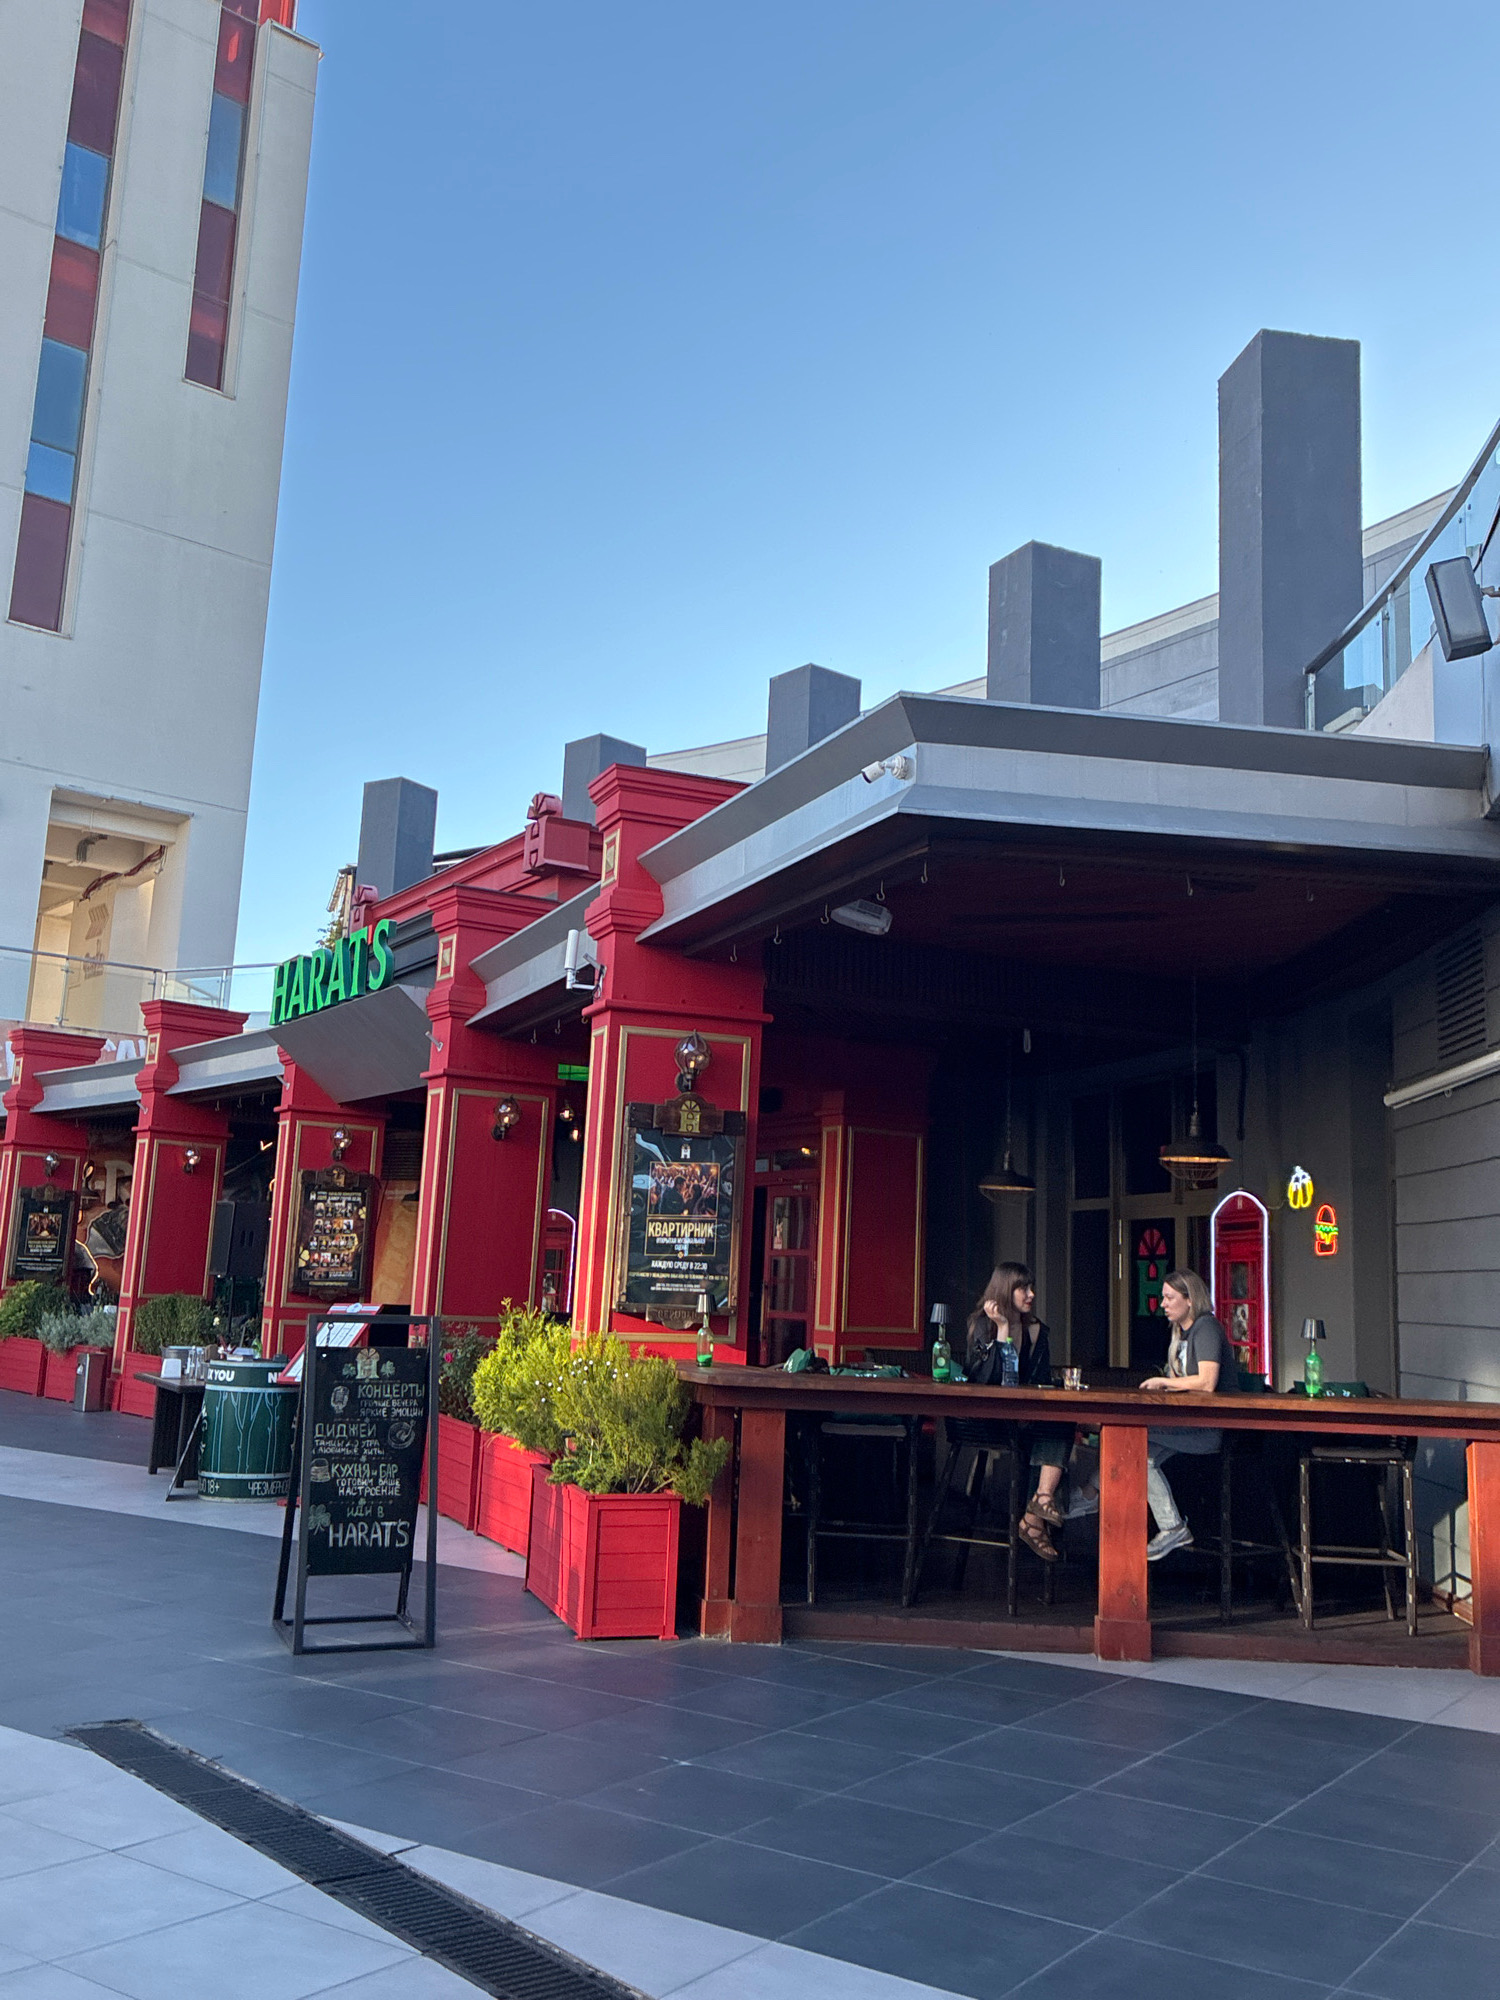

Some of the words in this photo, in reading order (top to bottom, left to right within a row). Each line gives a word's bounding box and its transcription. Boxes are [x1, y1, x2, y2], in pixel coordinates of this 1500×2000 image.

[269, 918, 395, 1025] HARAT'S
[648, 1222, 714, 1238] КВАРТИРНИК
[651, 1260, 673, 1269] КАЖДУЮ
[674, 1261, 689, 1270] СРЕДУ
[214, 1369, 235, 1382] YOU
[358, 1384, 425, 1399] КОНЦЕРТЫ
[360, 1408, 388, 1417] ЯРКИЕ
[391, 1407, 424, 1417] ЭМОЦИИ
[331, 1463, 370, 1478] КУХНЯ
[379, 1464, 399, 1479] БАР
[207, 1480, 220, 1493] 18+
[336, 1479, 373, 1487] ГОТОВИМ
[378, 1478, 401, 1486] ВАШЕ
[338, 1486, 401, 1496] НАСТРОЕНИЕ
[346, 1506, 372, 1518] ИДИ
